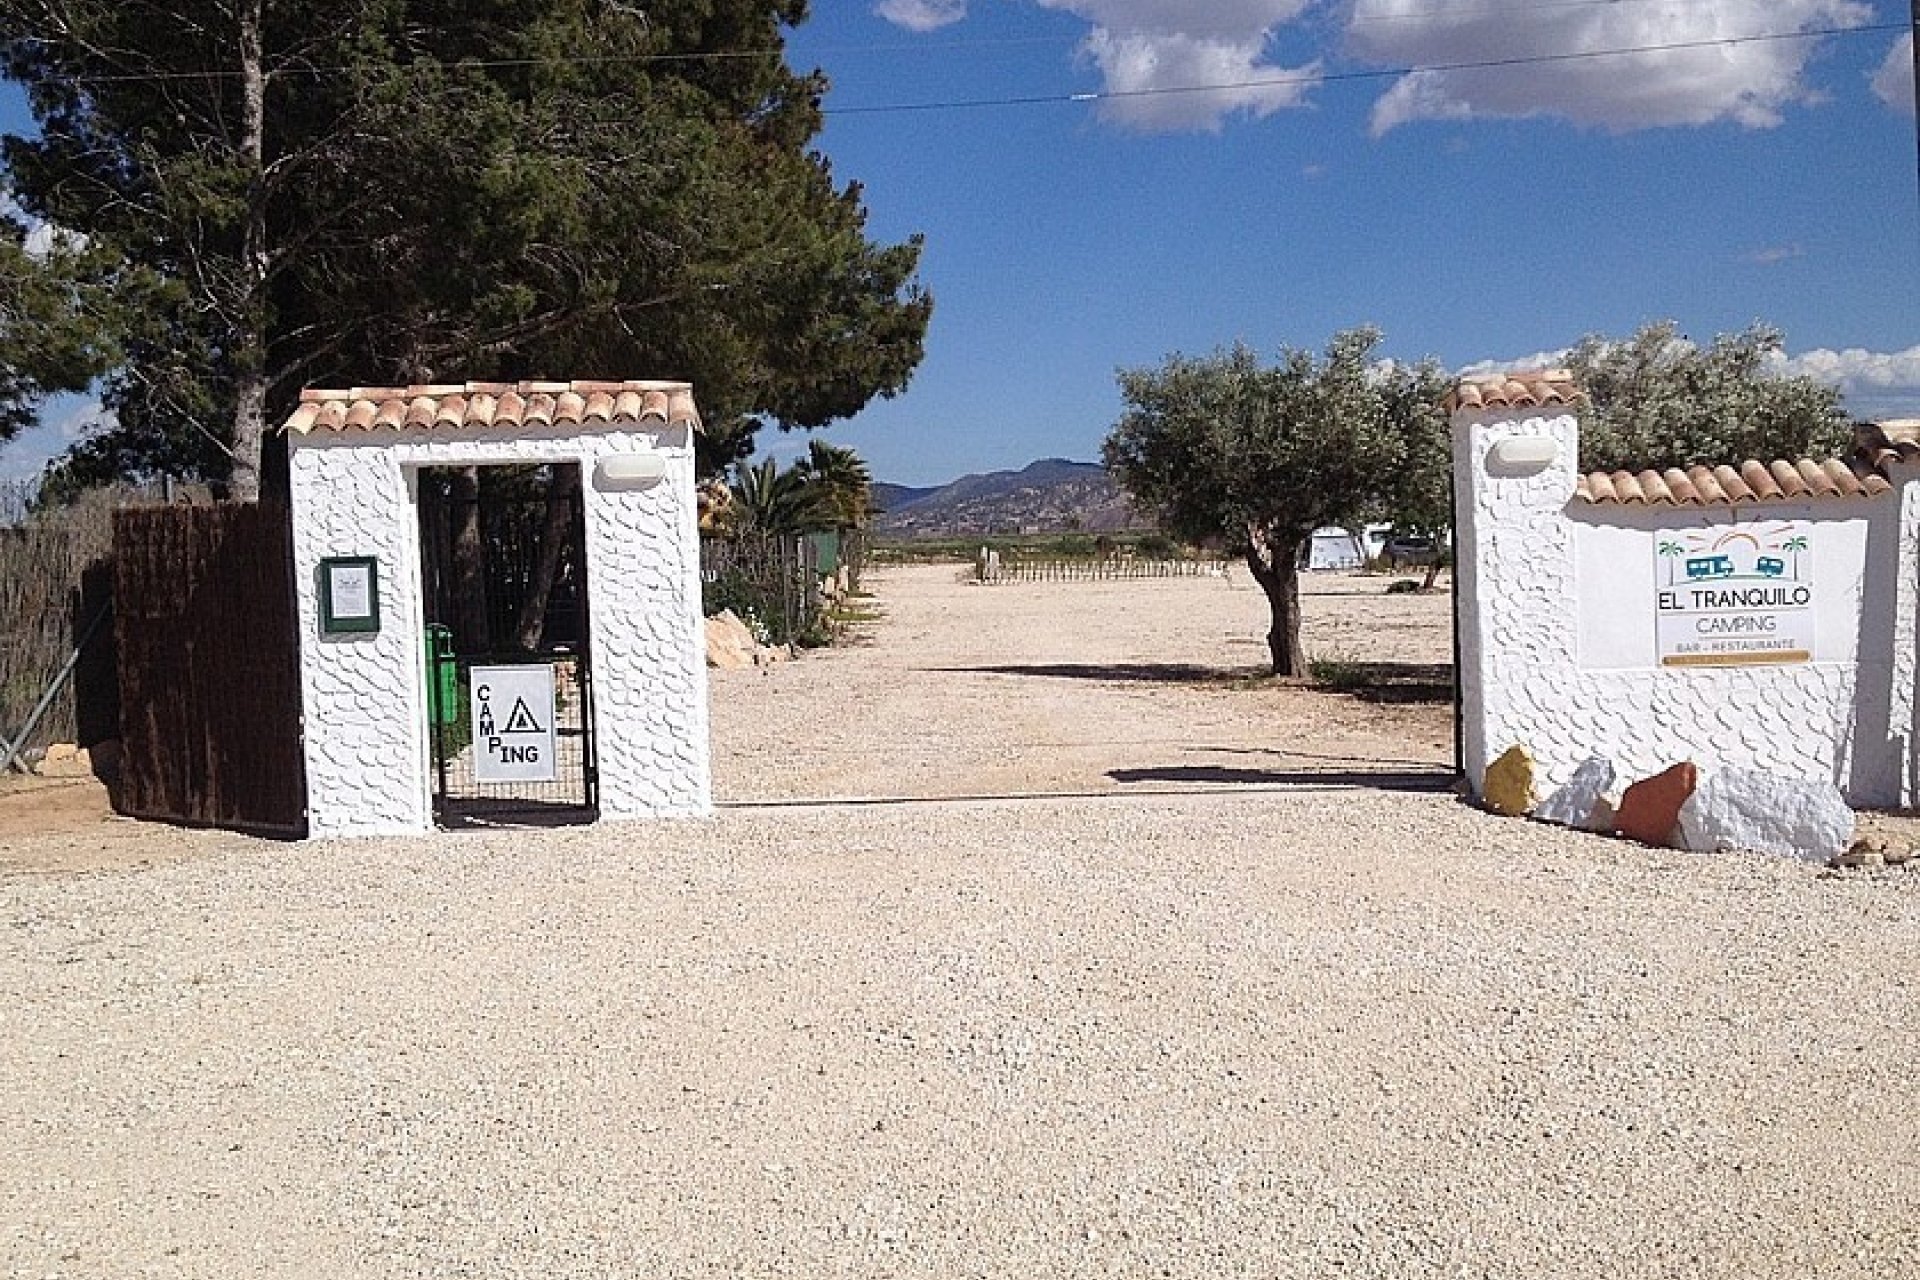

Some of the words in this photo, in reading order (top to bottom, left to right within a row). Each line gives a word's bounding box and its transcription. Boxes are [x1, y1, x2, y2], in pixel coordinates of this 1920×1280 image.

[1659, 592, 1685, 610] EL
[1691, 586, 1811, 608] TRANQUILO
[1696, 615, 1776, 633] CAMPING
[1676, 642, 1701, 652] BAR
[1711, 639, 1795, 651] RESTAURANTE
[477, 684, 539, 763] CAMPING
